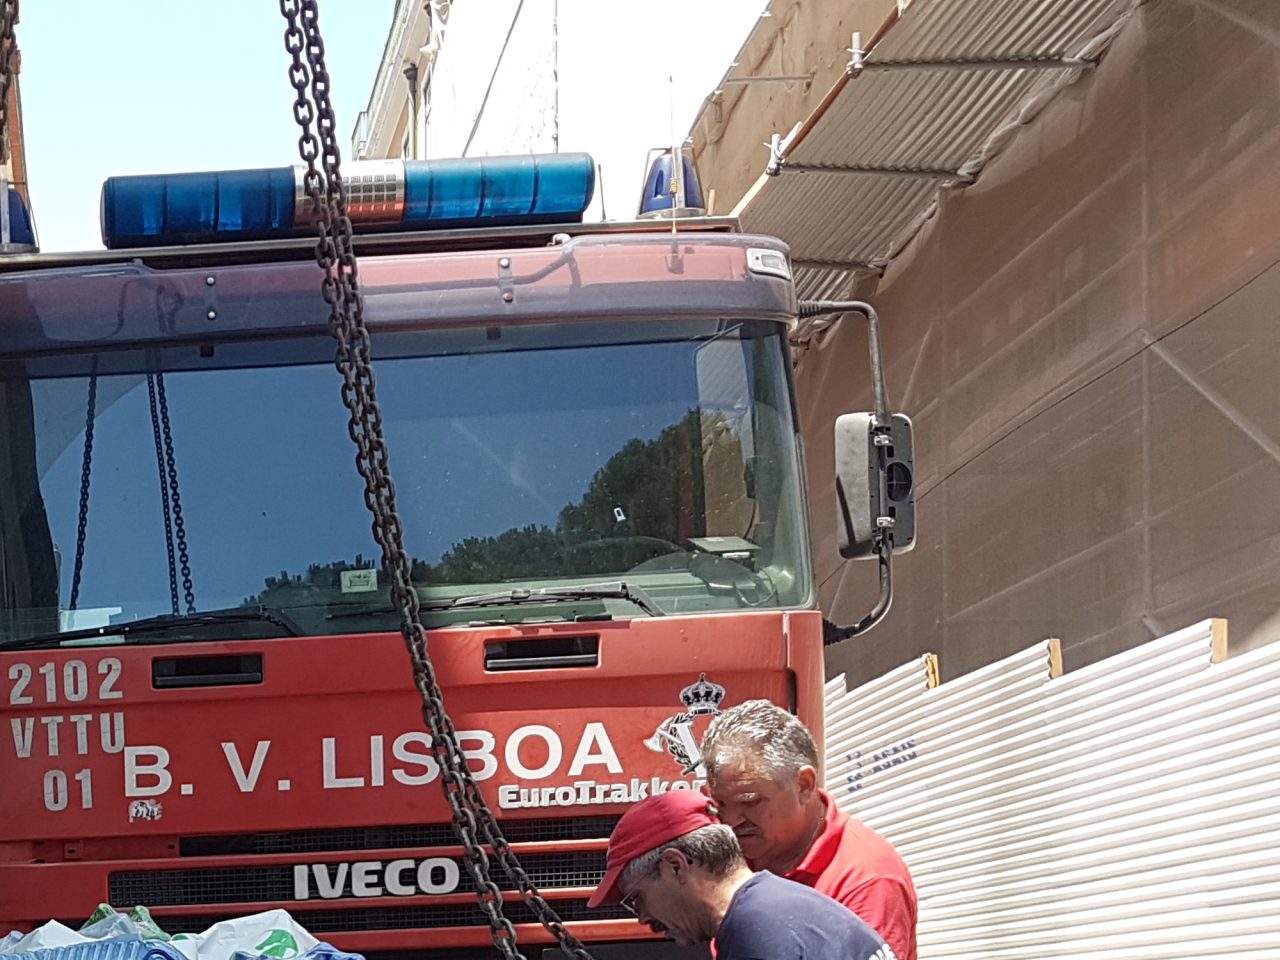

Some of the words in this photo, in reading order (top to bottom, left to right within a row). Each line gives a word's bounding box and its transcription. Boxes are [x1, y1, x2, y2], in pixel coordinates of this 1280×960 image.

[8, 657, 124, 705] 2102
[10, 711, 125, 758] VTTU
[124, 744, 194, 798] B.
[220, 739, 292, 793] V.
[322, 721, 624, 790] LISBOA
[42, 767, 93, 812] 01
[293, 857, 461, 901] IVECO
